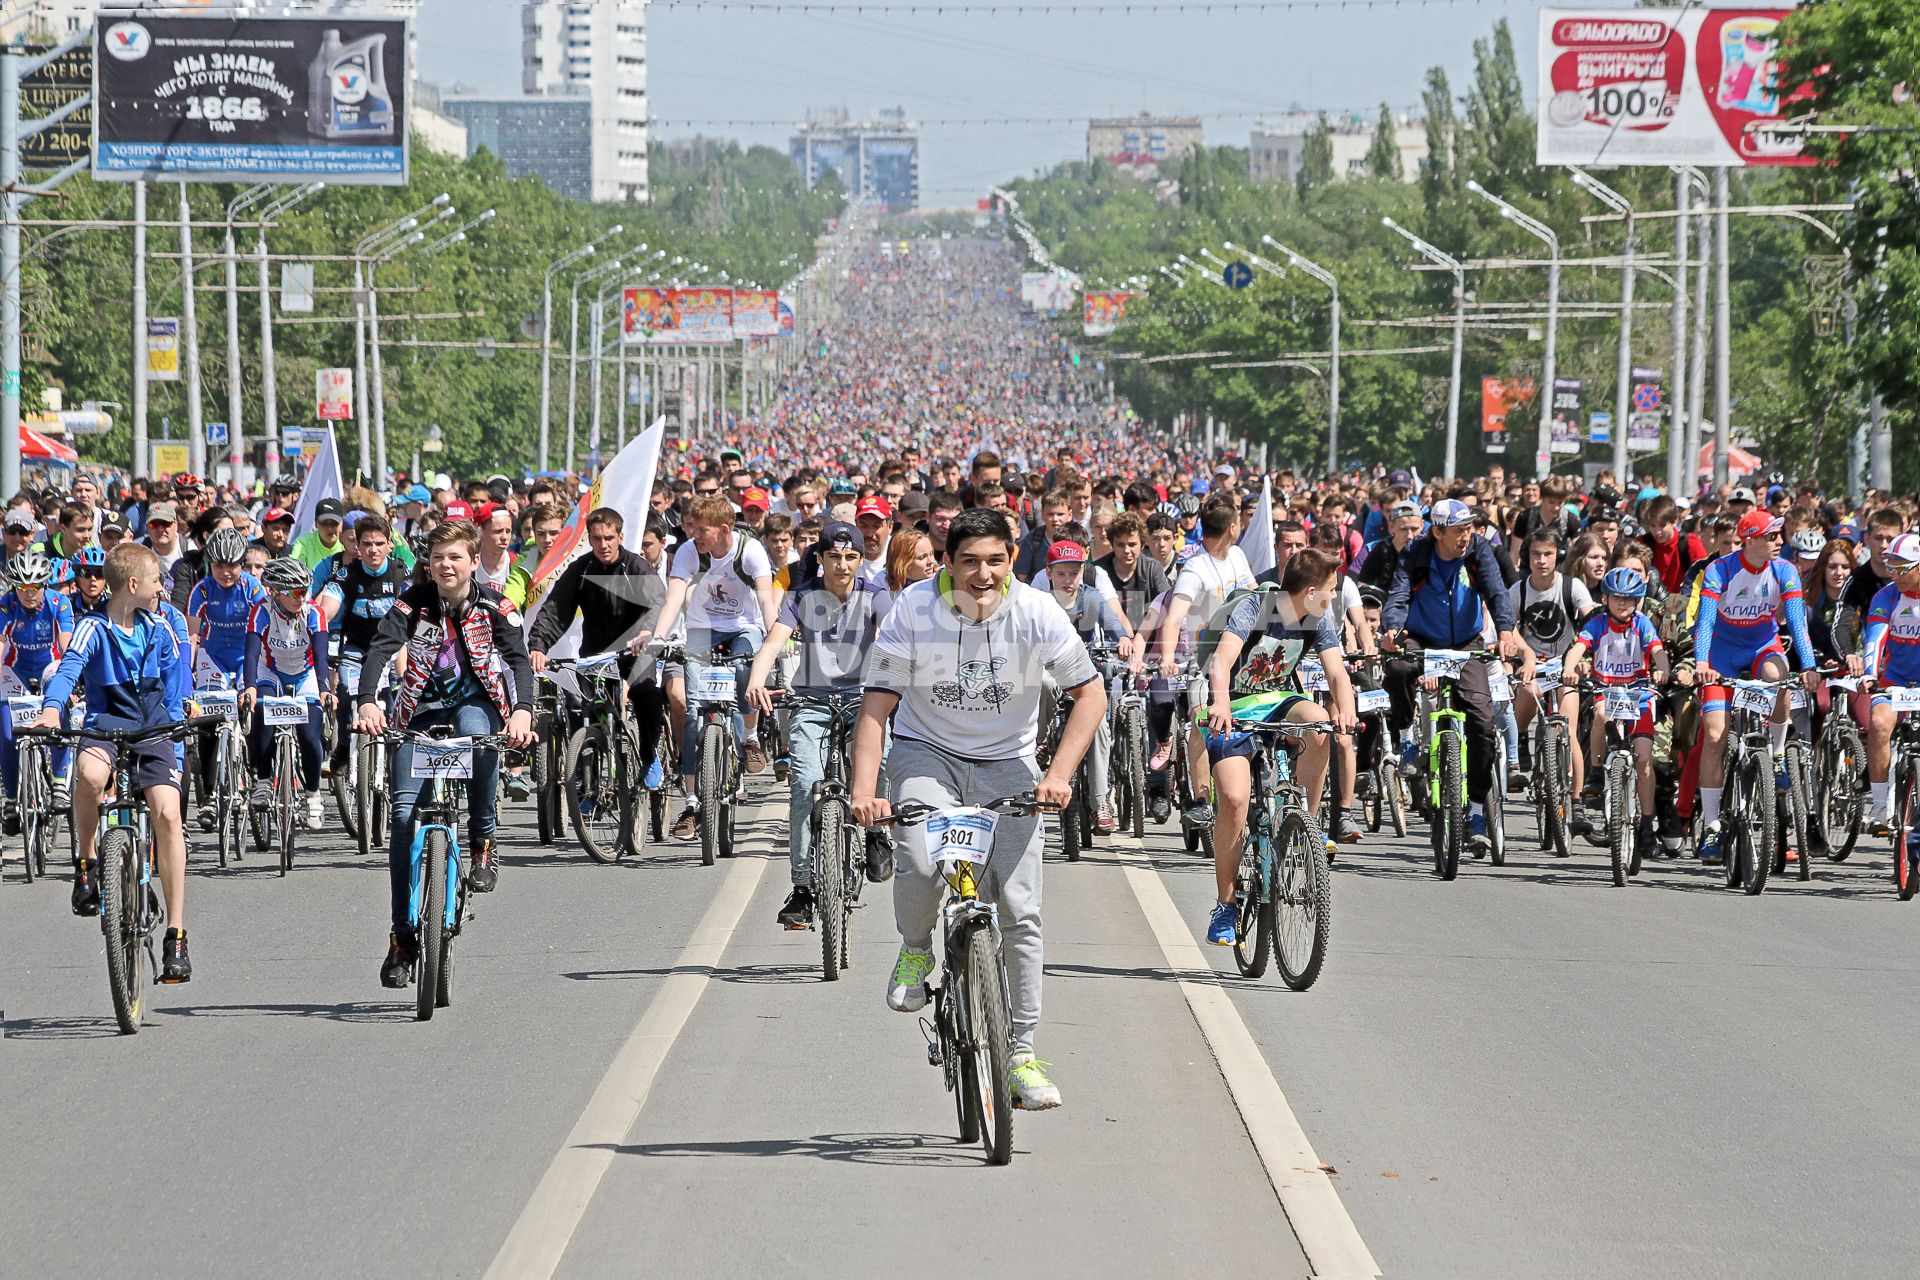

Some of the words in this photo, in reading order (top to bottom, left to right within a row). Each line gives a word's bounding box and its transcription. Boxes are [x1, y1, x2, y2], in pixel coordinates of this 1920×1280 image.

[1571, 23, 1662, 41] ЭЛЬДОРАДО
[174, 54, 206, 76] МЫ
[1577, 61, 1666, 78] ВЫИГРЫШ
[154, 76, 188, 98] ЧЕГО
[188, 70, 231, 88] ХОТЯТ
[186, 96, 262, 121] 1866
[1587, 88, 1674, 117] 100%
[209, 120, 236, 133] ГОДА
[1055, 546, 1079, 557] Vans
[706, 681, 729, 691] 7777
[202, 704, 233, 715] 10550
[270, 707, 303, 718] 10588
[941, 828, 974, 847] 5801
